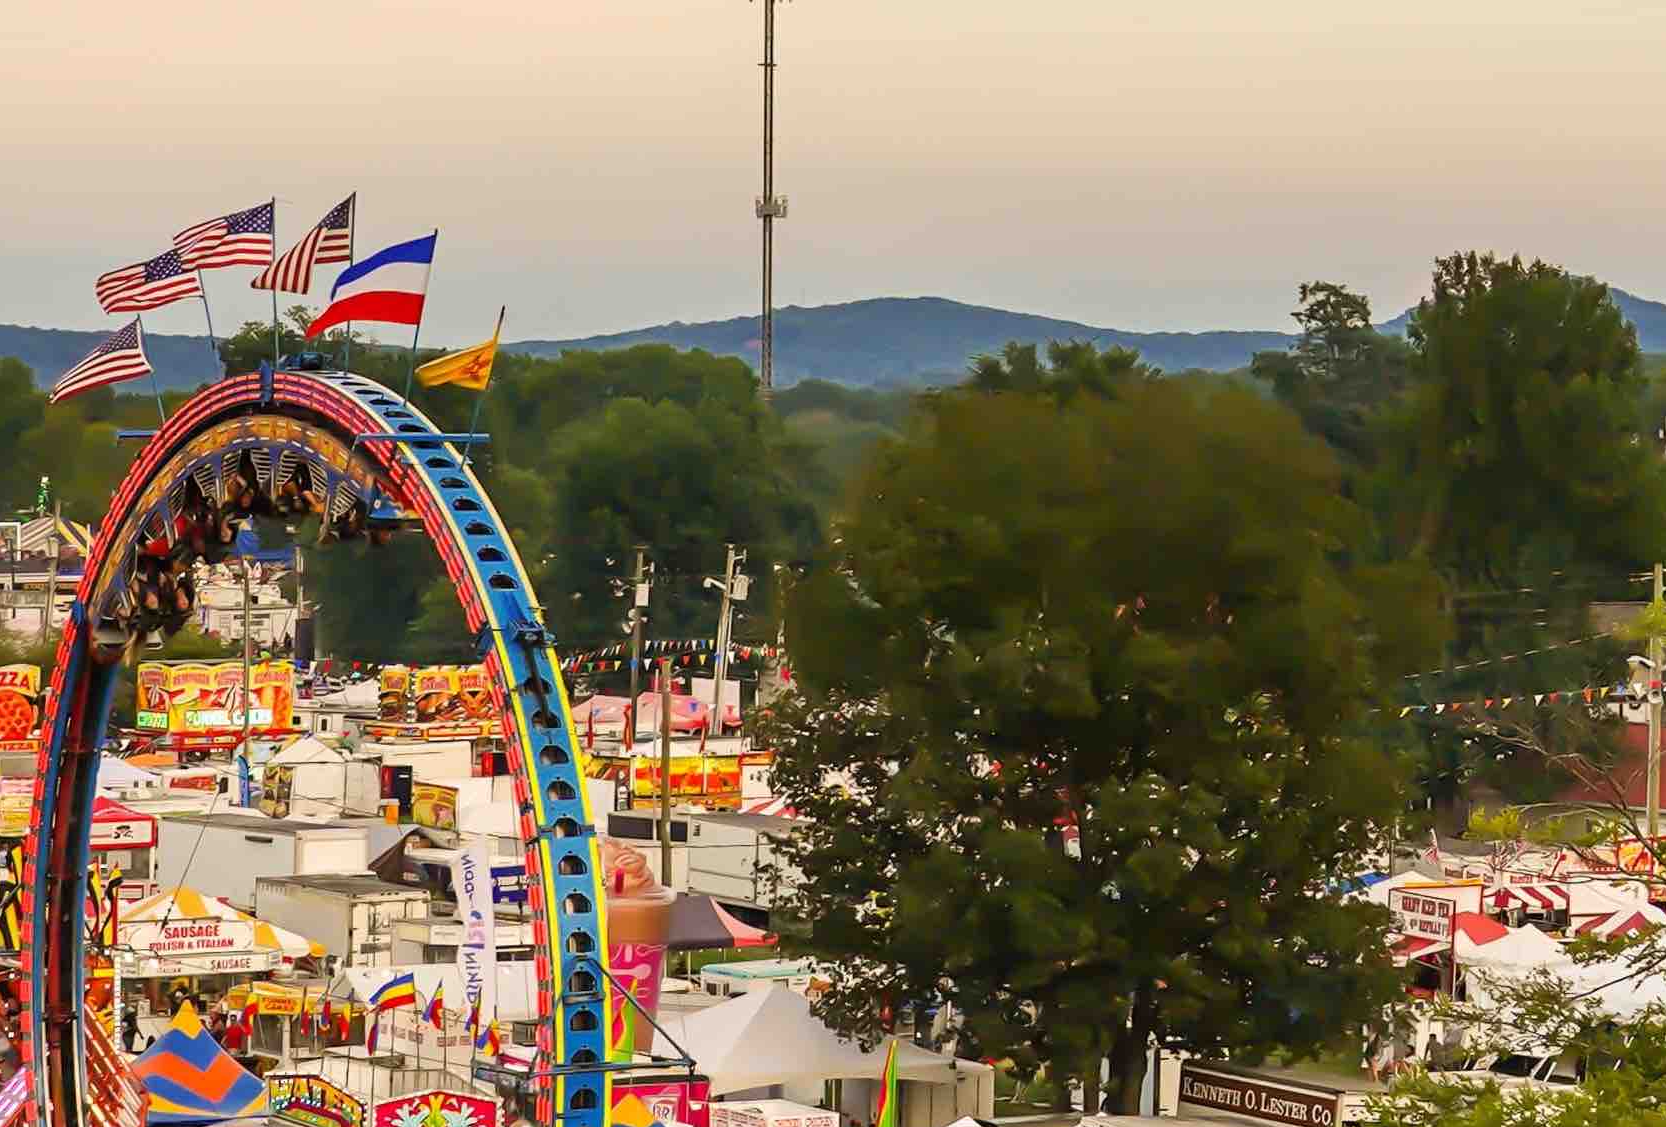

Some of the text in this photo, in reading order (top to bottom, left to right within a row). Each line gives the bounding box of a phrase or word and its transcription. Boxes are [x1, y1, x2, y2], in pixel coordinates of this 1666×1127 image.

[164, 924, 221, 940] SAUSAGE
[196, 938, 235, 950] ITALIAN
[210, 959, 252, 971] SAUSAGE
[1182, 1076, 1242, 1107] KENNETH
[1245, 1090, 1259, 1111] O.
[1261, 1092, 1309, 1122] LESTER
